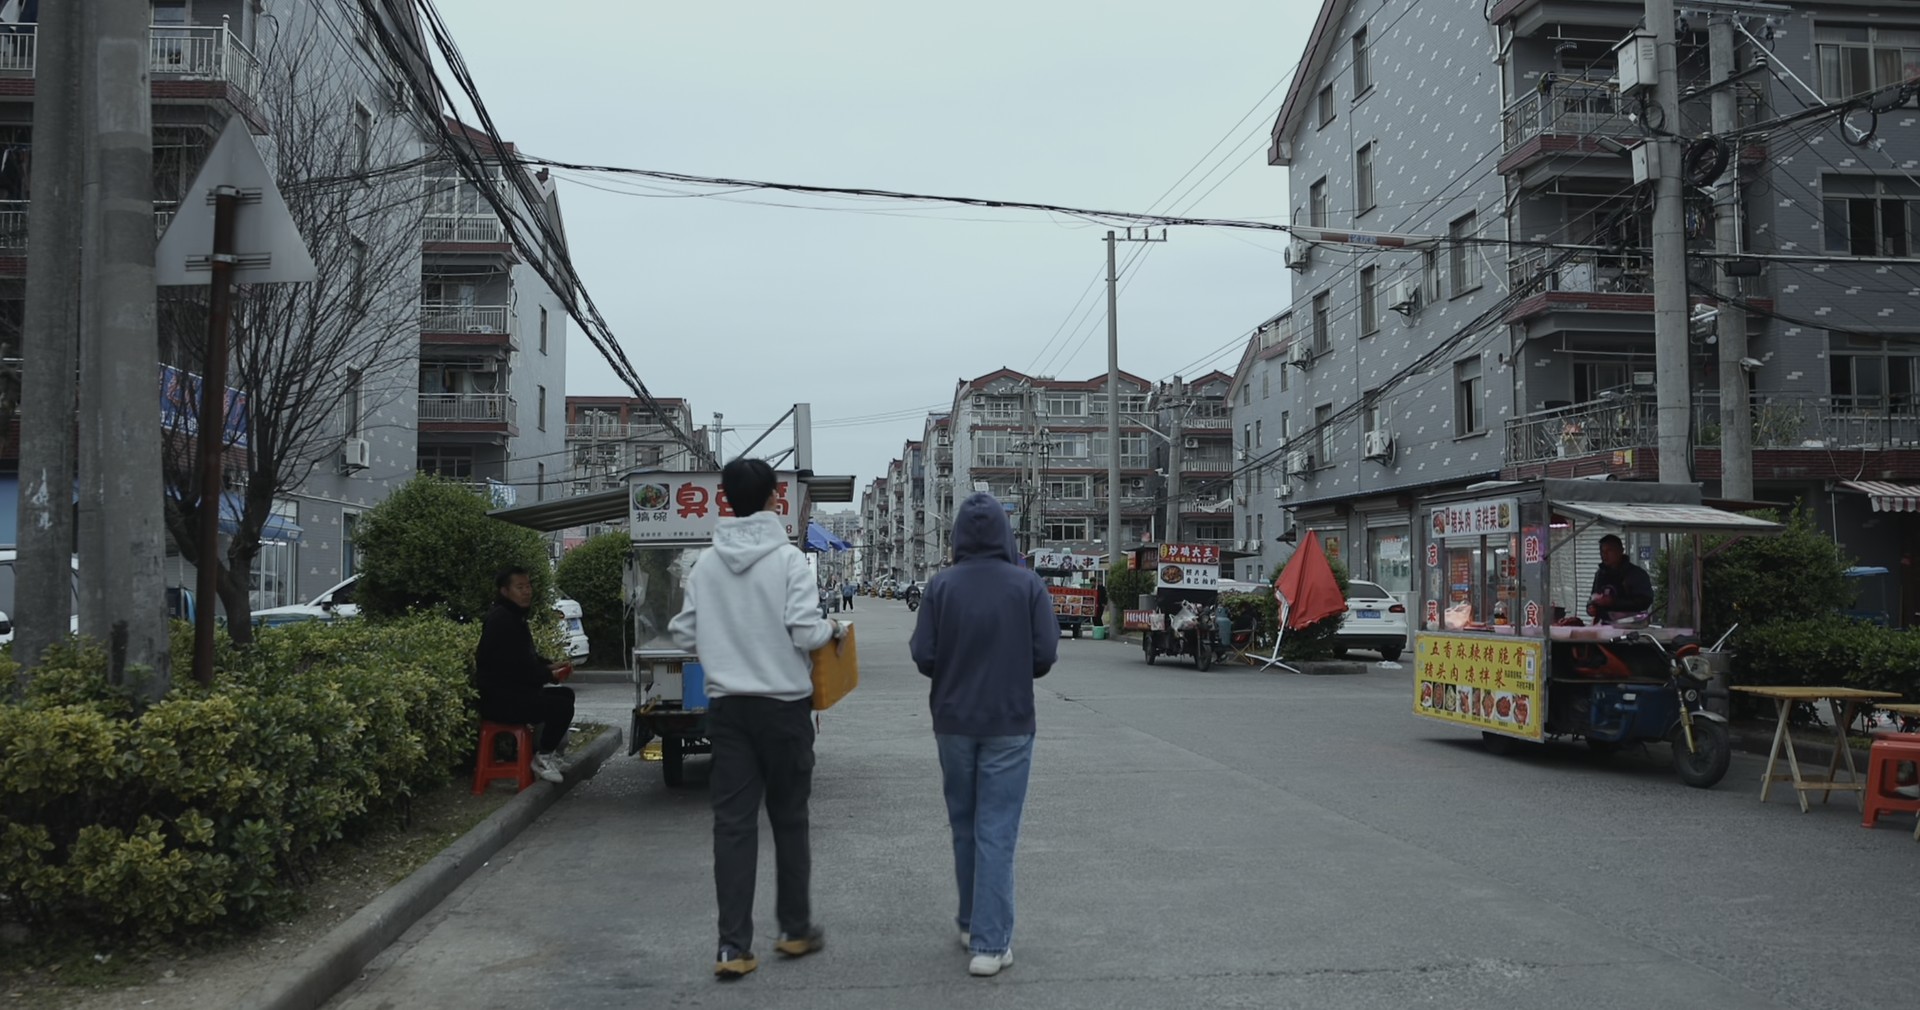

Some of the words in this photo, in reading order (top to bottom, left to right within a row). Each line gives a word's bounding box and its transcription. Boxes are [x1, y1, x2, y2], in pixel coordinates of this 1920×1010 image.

[1451, 509, 1472, 533] 猪头肉
[1475, 505, 1497, 532] 凉拌菜
[1168, 545, 1213, 558] 炒鸡大王
[1430, 641, 1526, 668] 五香麻辣猪脆骨
[1424, 661, 1459, 682] 猪头肉
[1465, 665, 1506, 689] 凉拌菜
